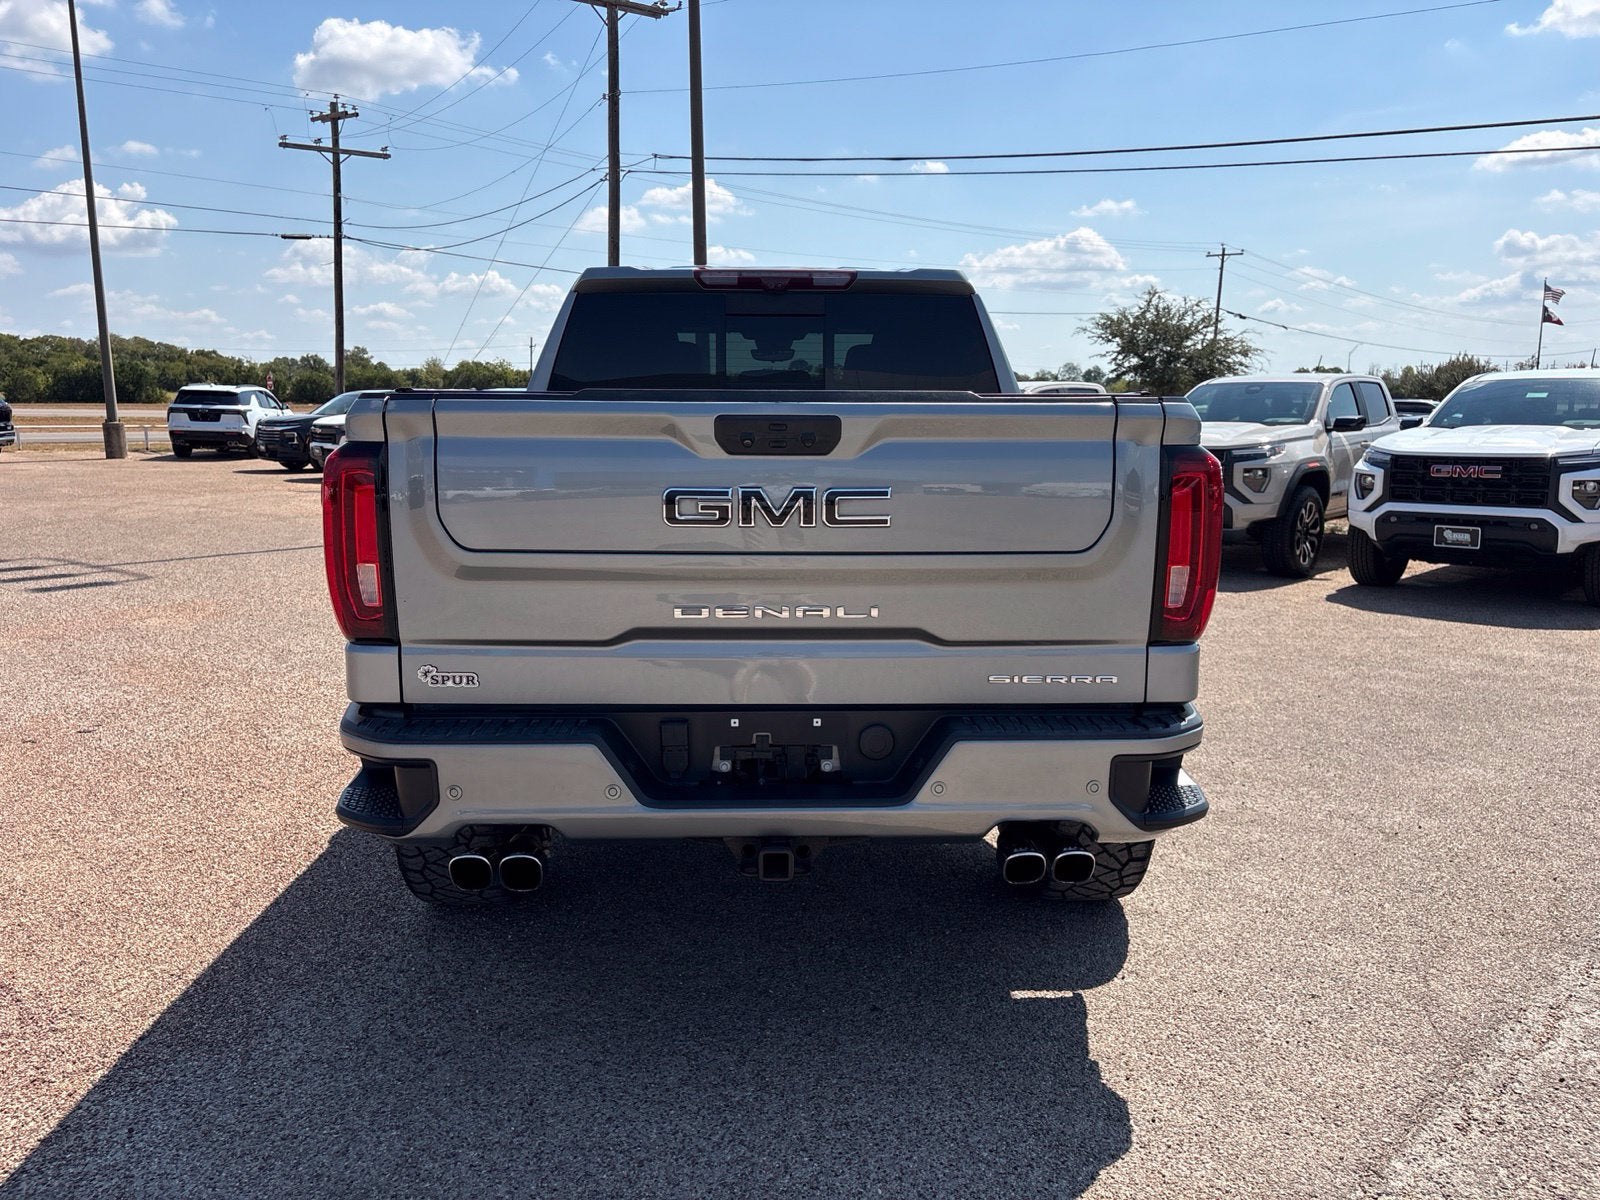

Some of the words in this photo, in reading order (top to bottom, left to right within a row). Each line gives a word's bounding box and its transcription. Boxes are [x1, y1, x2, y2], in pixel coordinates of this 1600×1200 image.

[1430, 464, 1502, 479] GMC
[662, 486, 892, 528] GMC
[673, 604, 880, 619] DENALI
[430, 675, 476, 685] SPUR
[988, 674, 1119, 684] SIERRA
